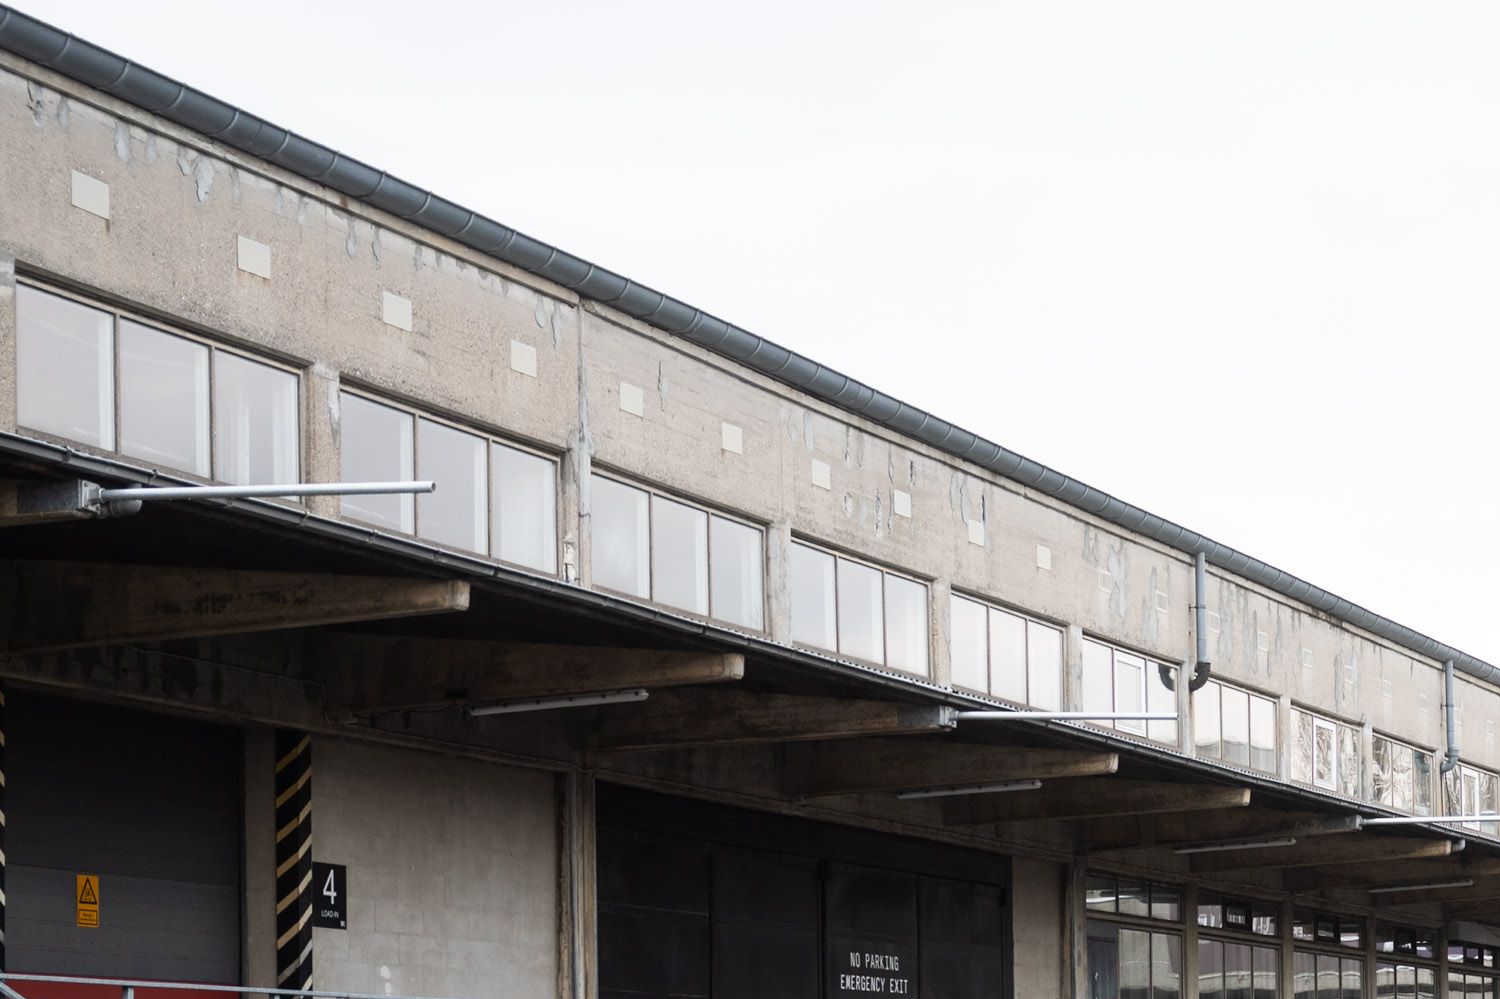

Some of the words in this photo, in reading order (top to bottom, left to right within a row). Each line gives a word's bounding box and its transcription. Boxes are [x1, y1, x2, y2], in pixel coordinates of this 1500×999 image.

[323, 869, 337, 904] 4
[850, 952, 860, 968] NO
[865, 953, 899, 971] PARKING
[840, 974, 885, 992] EMERGENCY
[890, 978, 908, 994] EXIT
